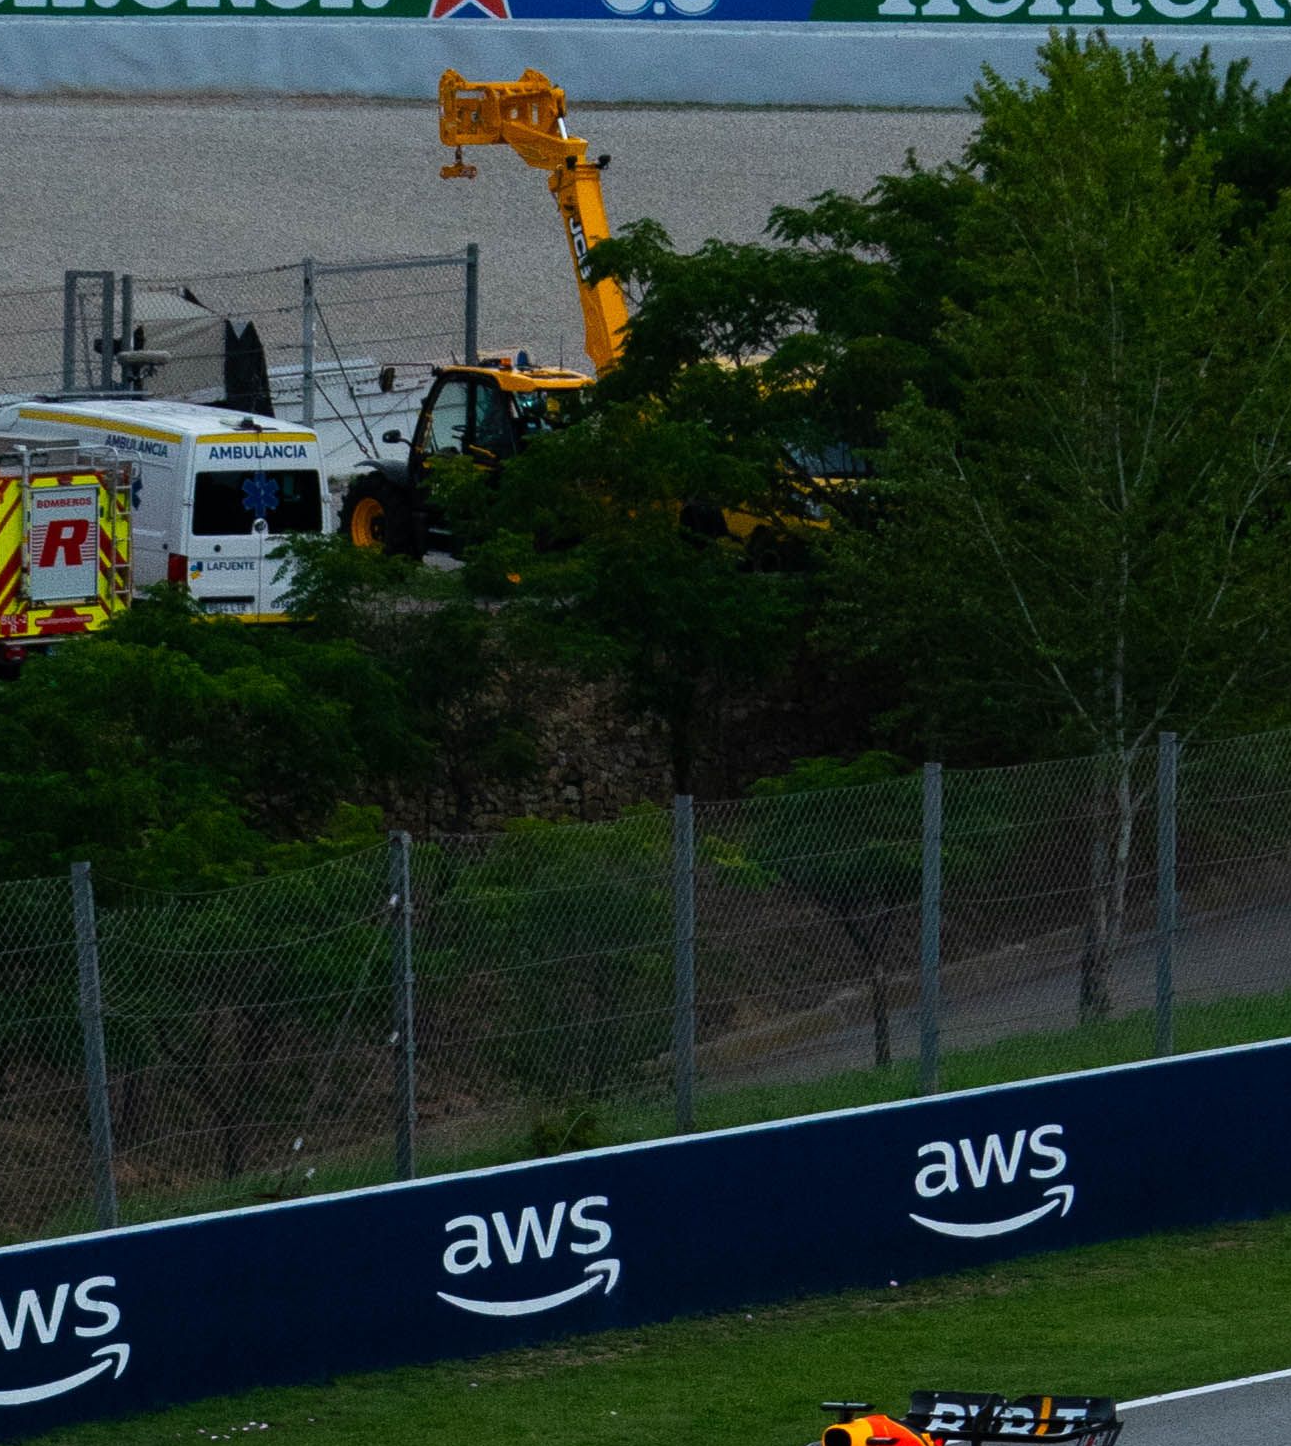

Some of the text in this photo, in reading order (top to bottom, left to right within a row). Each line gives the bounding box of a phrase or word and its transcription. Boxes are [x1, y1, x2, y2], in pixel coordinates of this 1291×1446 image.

[36, 496, 92, 509] BOMBEROS
[39, 519, 89, 567] R
[207, 561, 255, 571] LAFUENTE
[914, 1123, 1068, 1199] aws
[443, 1195, 614, 1276] aws
